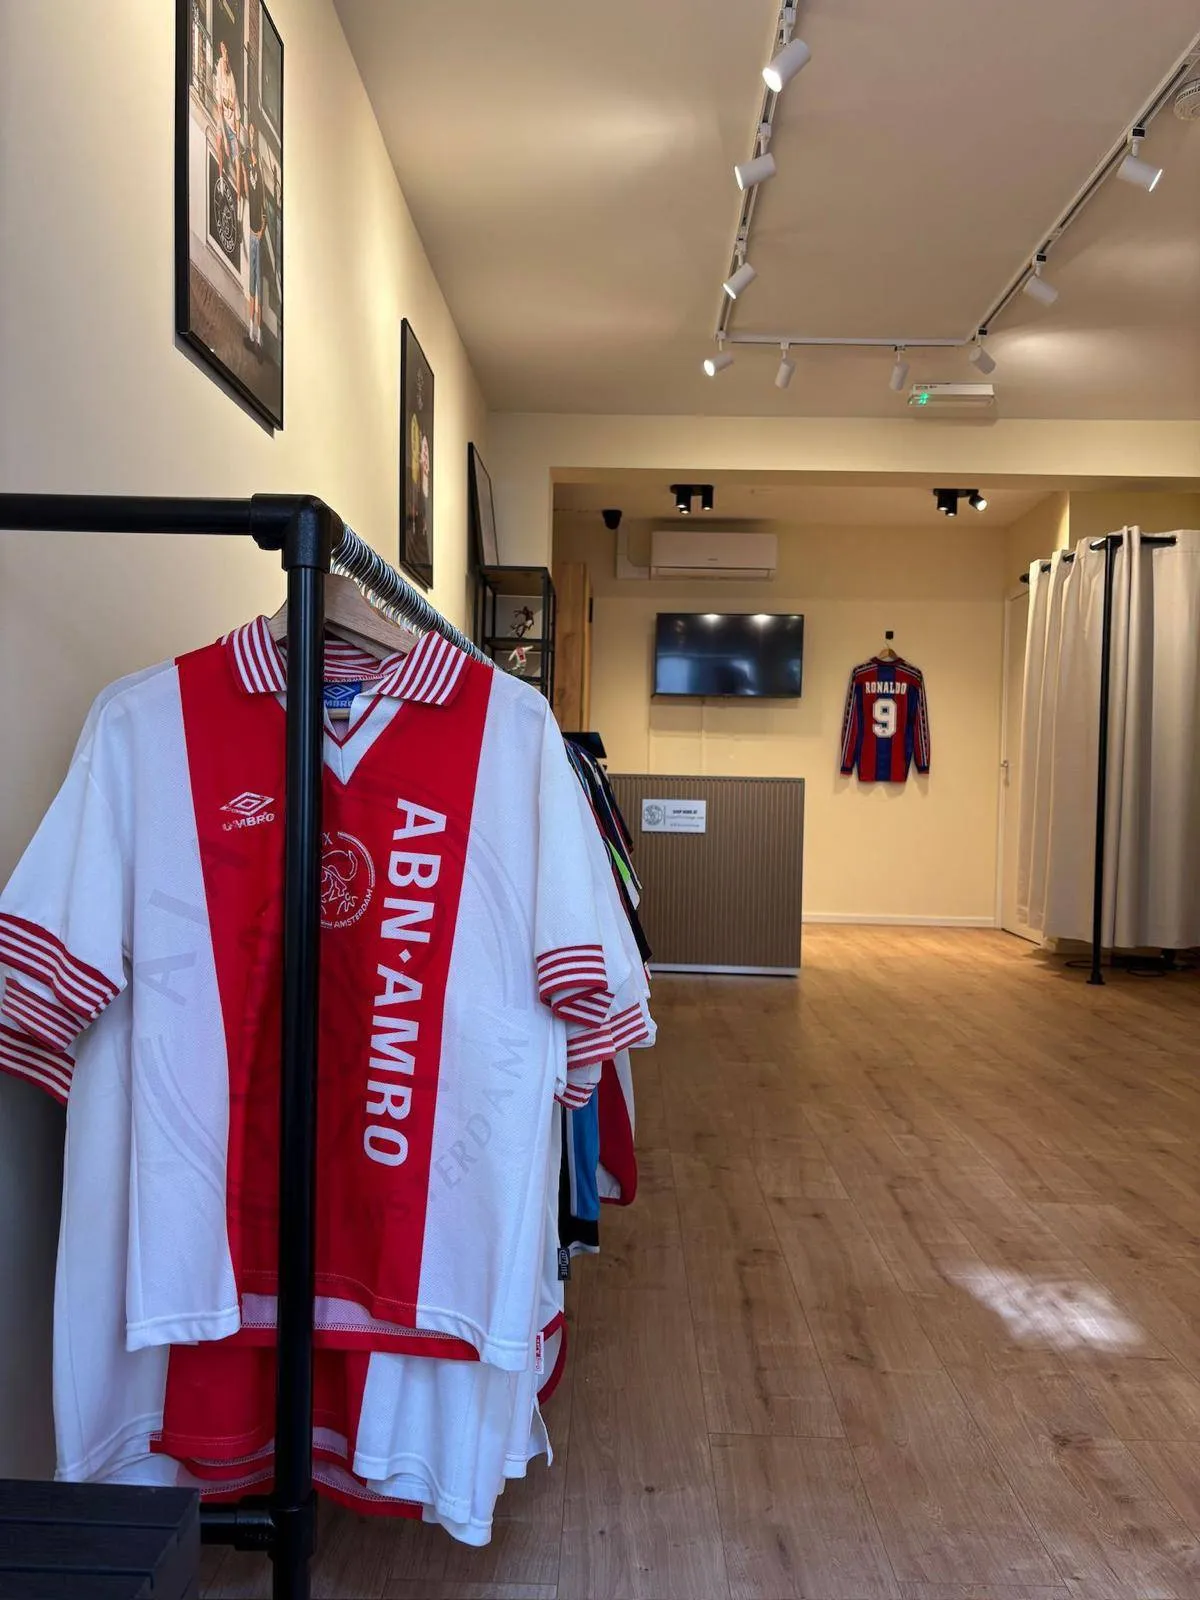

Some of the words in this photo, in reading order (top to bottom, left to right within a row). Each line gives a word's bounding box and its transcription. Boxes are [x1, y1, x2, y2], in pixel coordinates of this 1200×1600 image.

[865, 681, 908, 694] RONALDO
[872, 698, 898, 739] 9
[333, 888, 373, 929] AMSTERDAM
